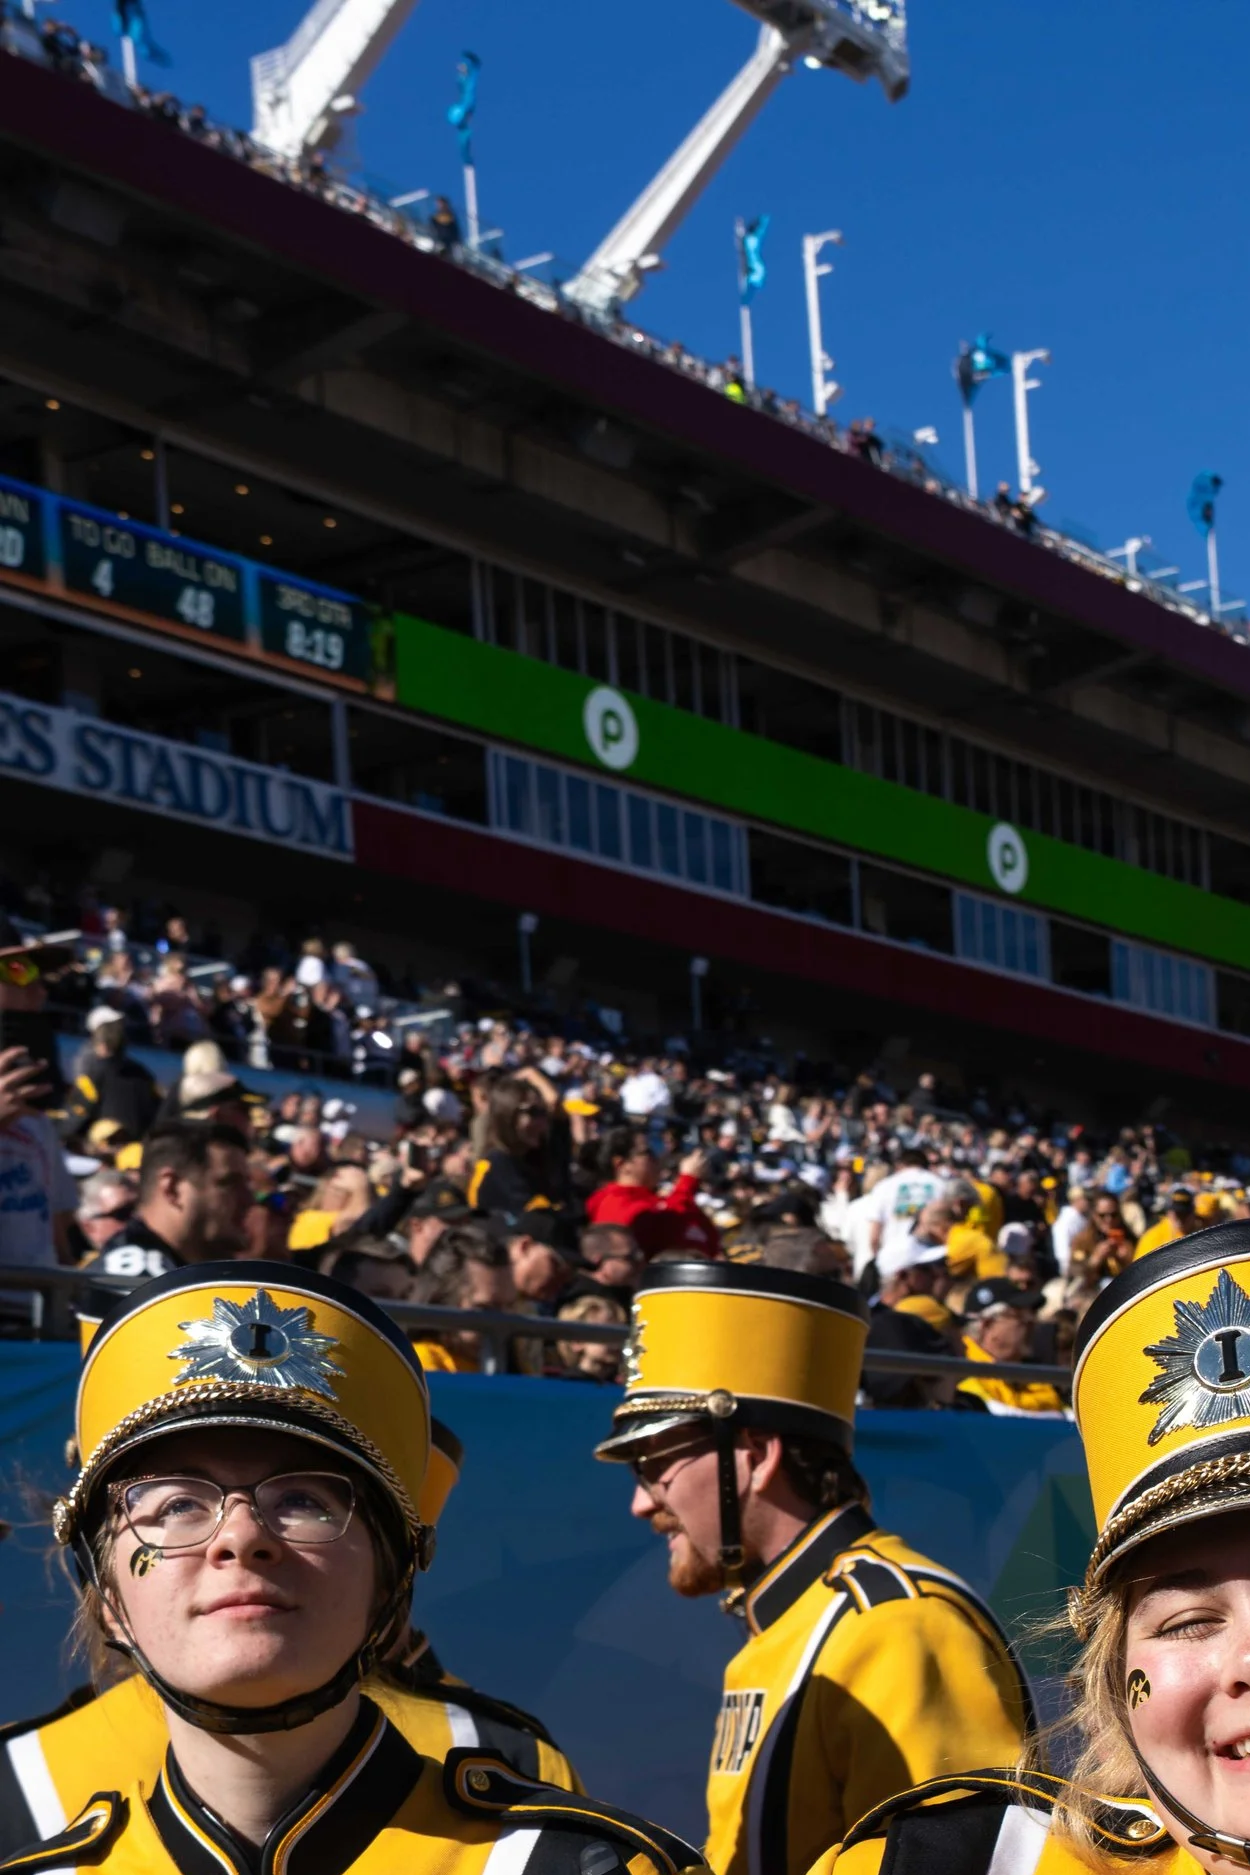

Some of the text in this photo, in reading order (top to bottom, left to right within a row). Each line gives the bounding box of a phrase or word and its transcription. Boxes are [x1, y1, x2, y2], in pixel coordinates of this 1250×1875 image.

[92, 558, 114, 597] 4
[76, 726, 348, 852] STADIUM
[1214, 1329, 1246, 1383] I
